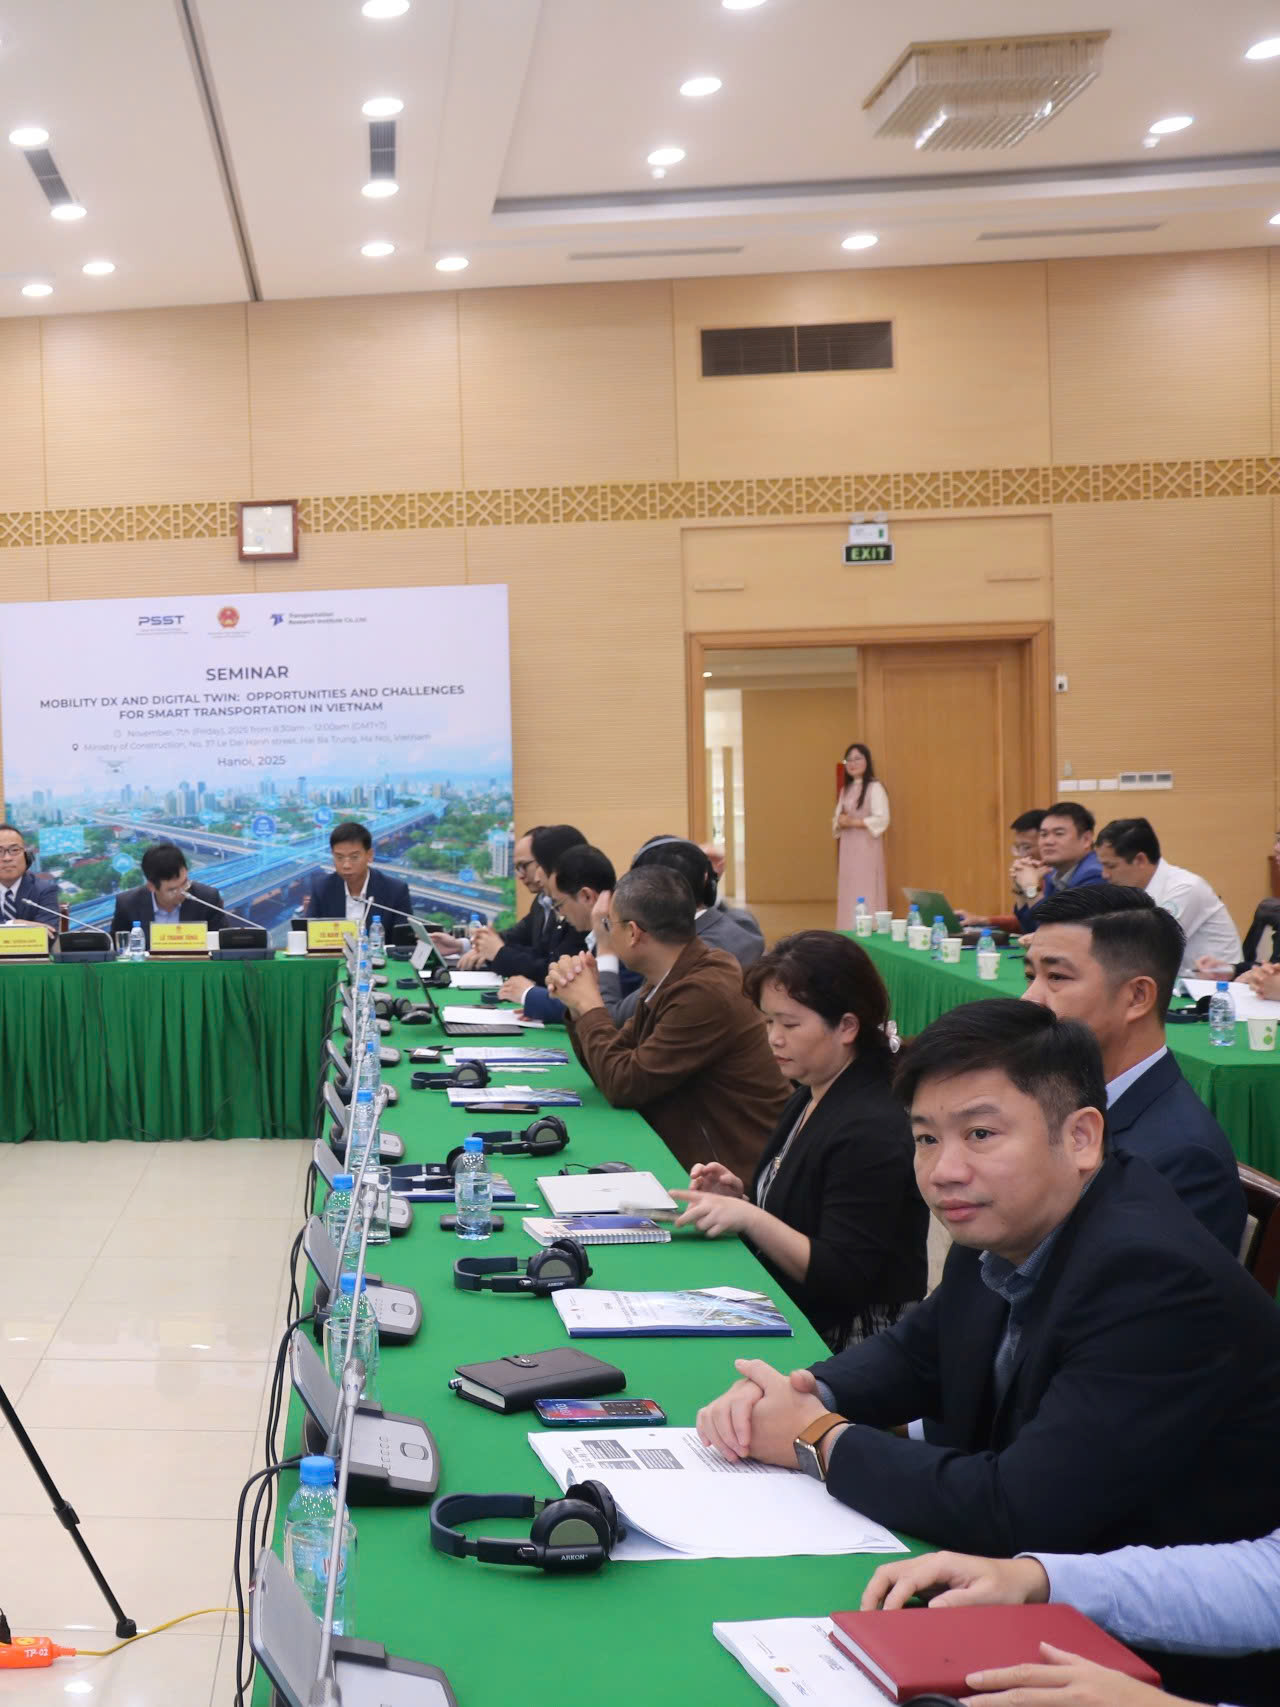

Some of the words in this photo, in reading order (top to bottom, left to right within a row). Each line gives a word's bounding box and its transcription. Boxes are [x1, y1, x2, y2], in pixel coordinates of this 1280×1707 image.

[851, 547, 886, 561] EXIT
[138, 615, 185, 626] PSST
[205, 665, 289, 681] SEMINAR
[40, 697, 98, 709] MOBILITY
[101, 696, 118, 707] DX
[122, 695, 149, 706] AND
[152, 694, 200, 705] DIGITAL
[204, 693, 240, 703] TWIN:
[246, 688, 347, 701] OPPORTUNITIES
[350, 687, 378, 698] AND
[381, 684, 465, 697] CHALLENGES
[119, 710, 144, 720] FOR
[147, 708, 189, 719] SMART
[193, 703, 307, 717] TRANSPORTATION
[310, 703, 322, 713] IN
[326, 702, 383, 713] VIETNAM
[217, 756, 255, 768] Hanoi,
[258, 756, 286, 766] 2025
